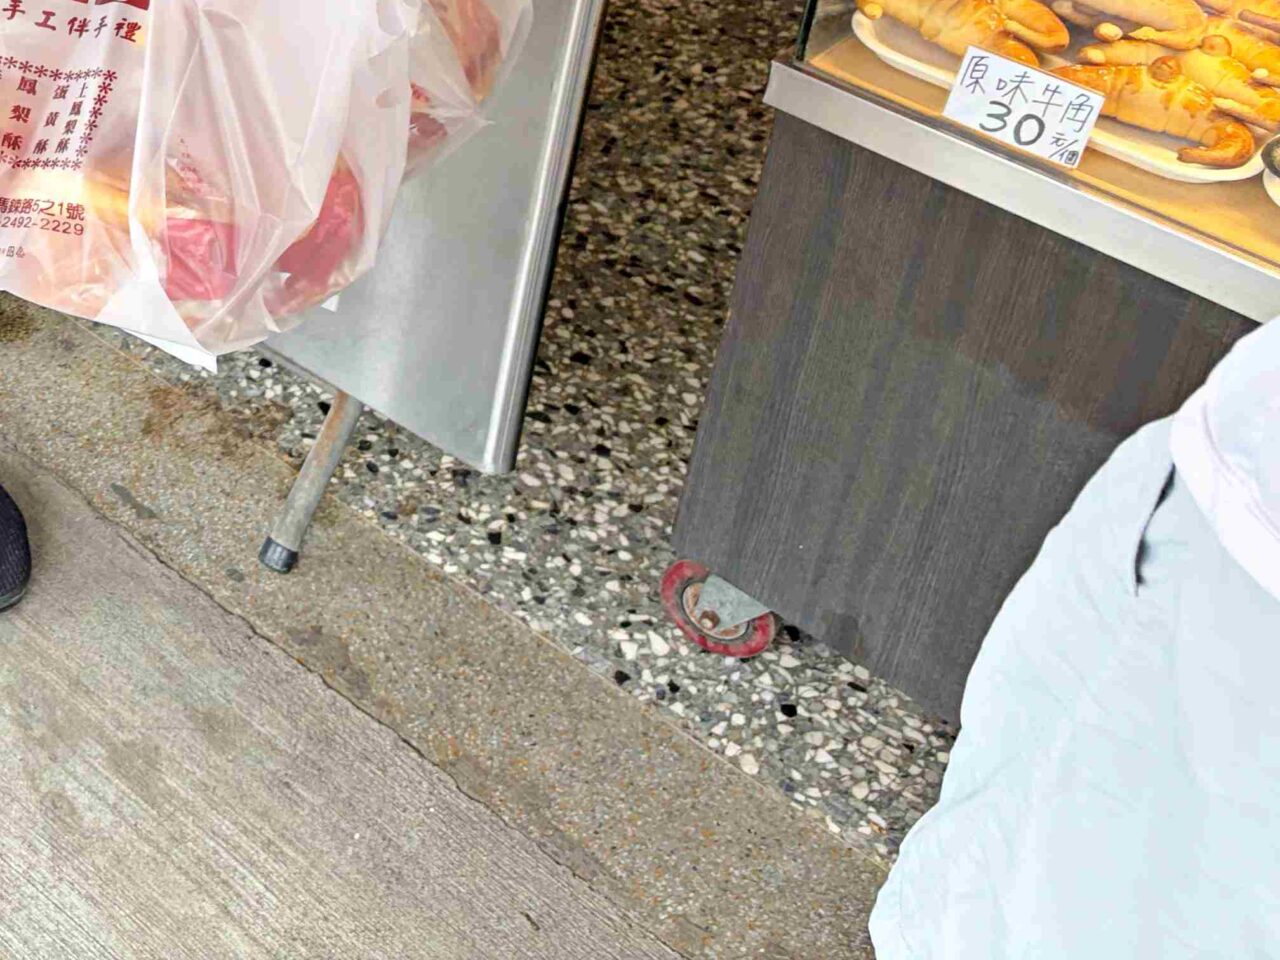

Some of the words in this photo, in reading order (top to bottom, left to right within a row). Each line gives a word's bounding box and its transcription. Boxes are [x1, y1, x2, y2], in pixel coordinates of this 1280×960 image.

[960, 56, 1094, 133] 原味牛角
[979, 100, 1046, 146] 30
